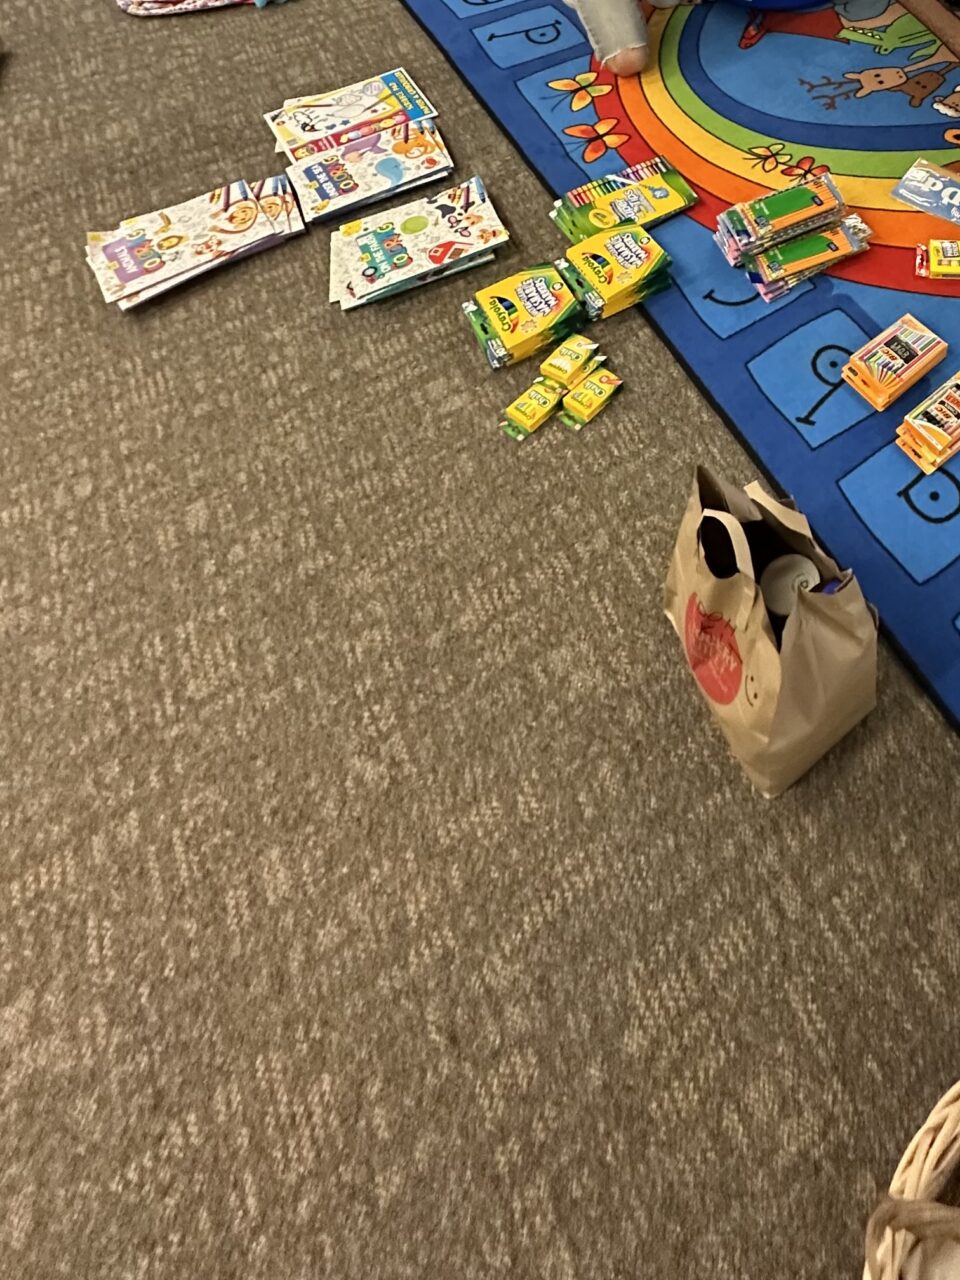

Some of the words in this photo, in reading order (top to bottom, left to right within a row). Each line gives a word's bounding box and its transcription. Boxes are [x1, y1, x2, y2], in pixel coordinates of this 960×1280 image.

[580, 253, 609, 285] Crayola
[609, 233, 644, 270] WASHABLE
[486, 296, 514, 333] Crayola
[519, 277, 553, 318] WASHABLE
